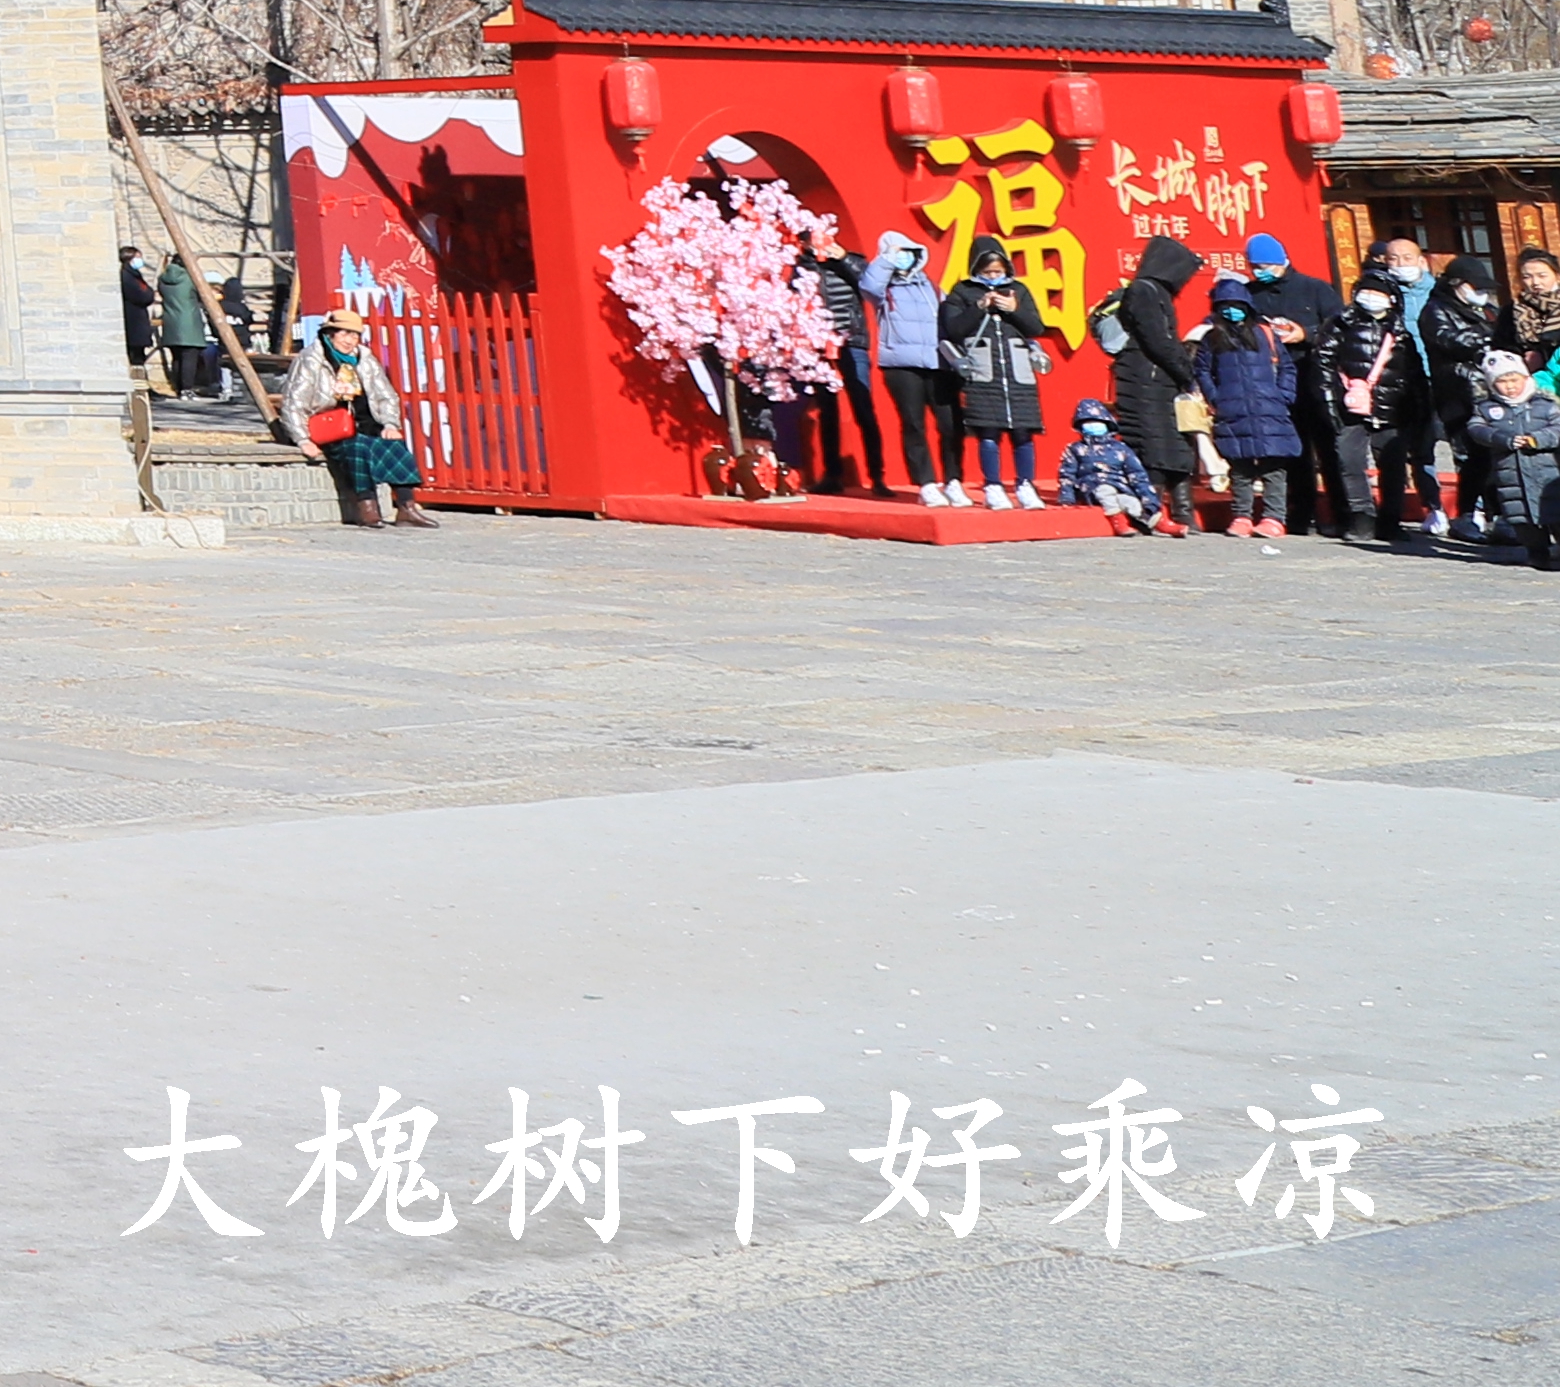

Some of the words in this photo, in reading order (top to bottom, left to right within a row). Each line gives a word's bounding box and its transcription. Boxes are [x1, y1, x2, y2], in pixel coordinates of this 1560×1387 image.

[922, 119, 1086, 350] 福
[1107, 139, 1269, 236] 长城脚下
[1132, 213, 1190, 239] 过大年
